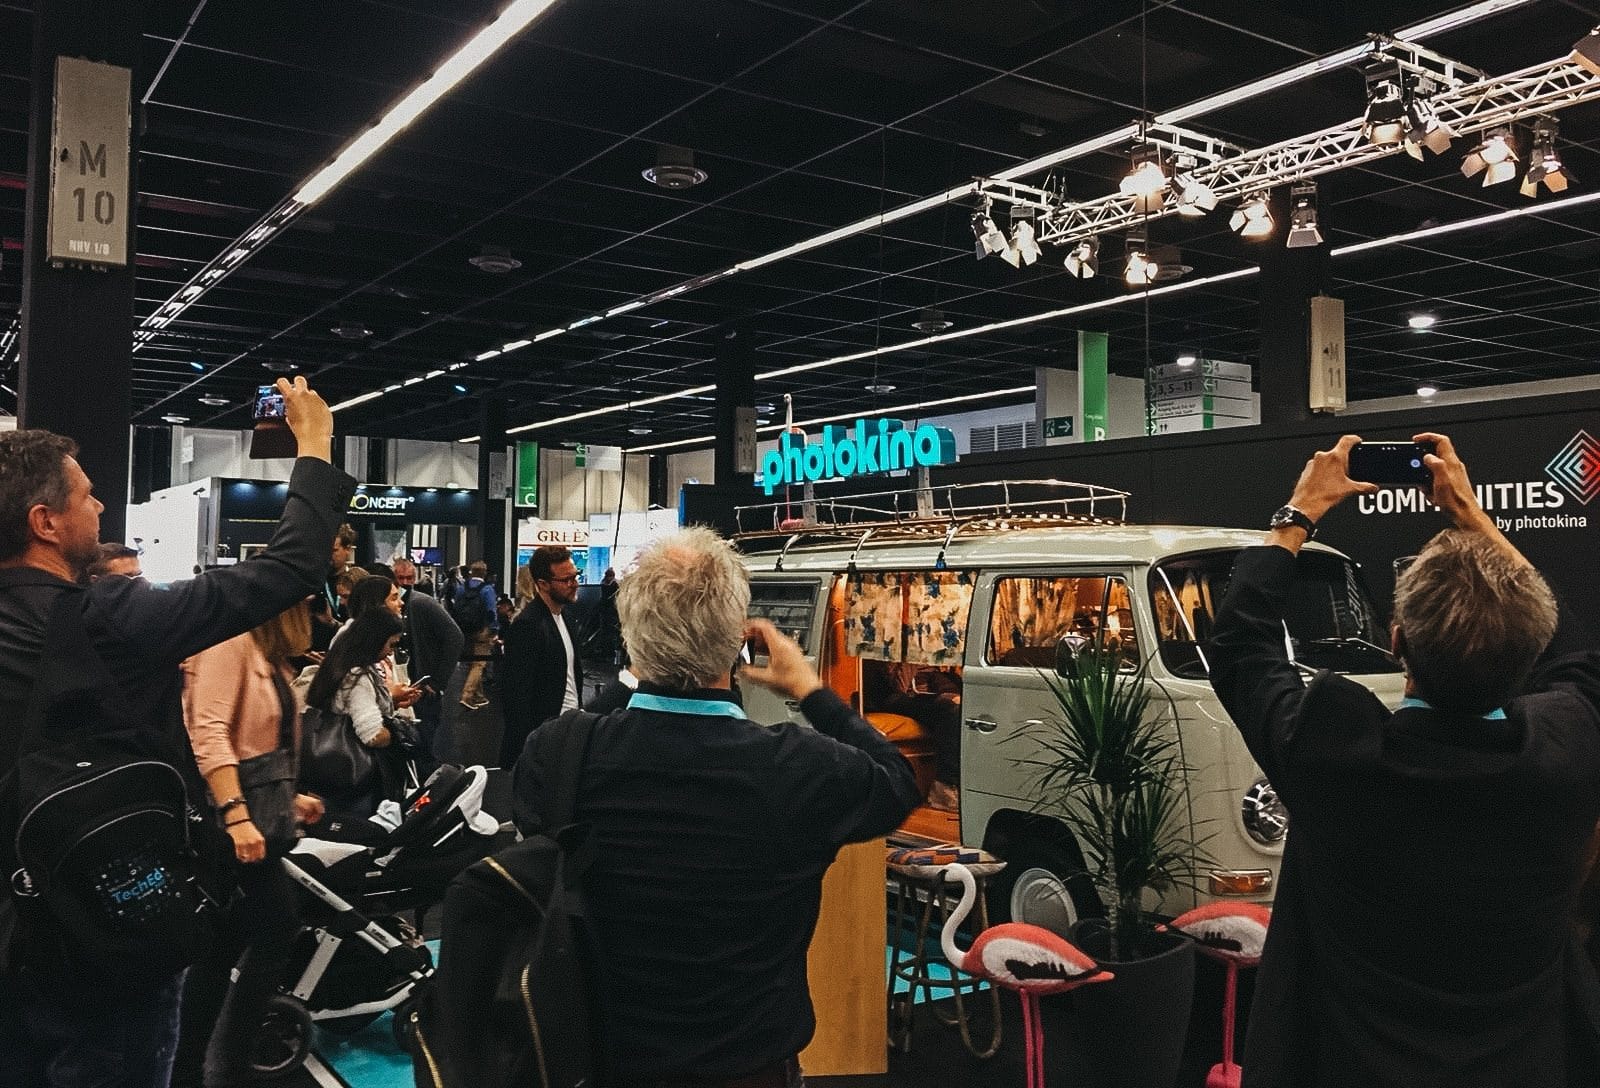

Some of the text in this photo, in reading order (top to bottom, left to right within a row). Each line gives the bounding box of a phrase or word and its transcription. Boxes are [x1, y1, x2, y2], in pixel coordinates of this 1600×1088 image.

[80, 140, 107, 178] M
[73, 187, 115, 225] 10
[1327, 367, 1342, 389] 11
[763, 418, 941, 496] photokina
[524, 492, 536, 506] C
[1496, 513, 1588, 533] by photokina
[111, 867, 165, 903] TechEd
